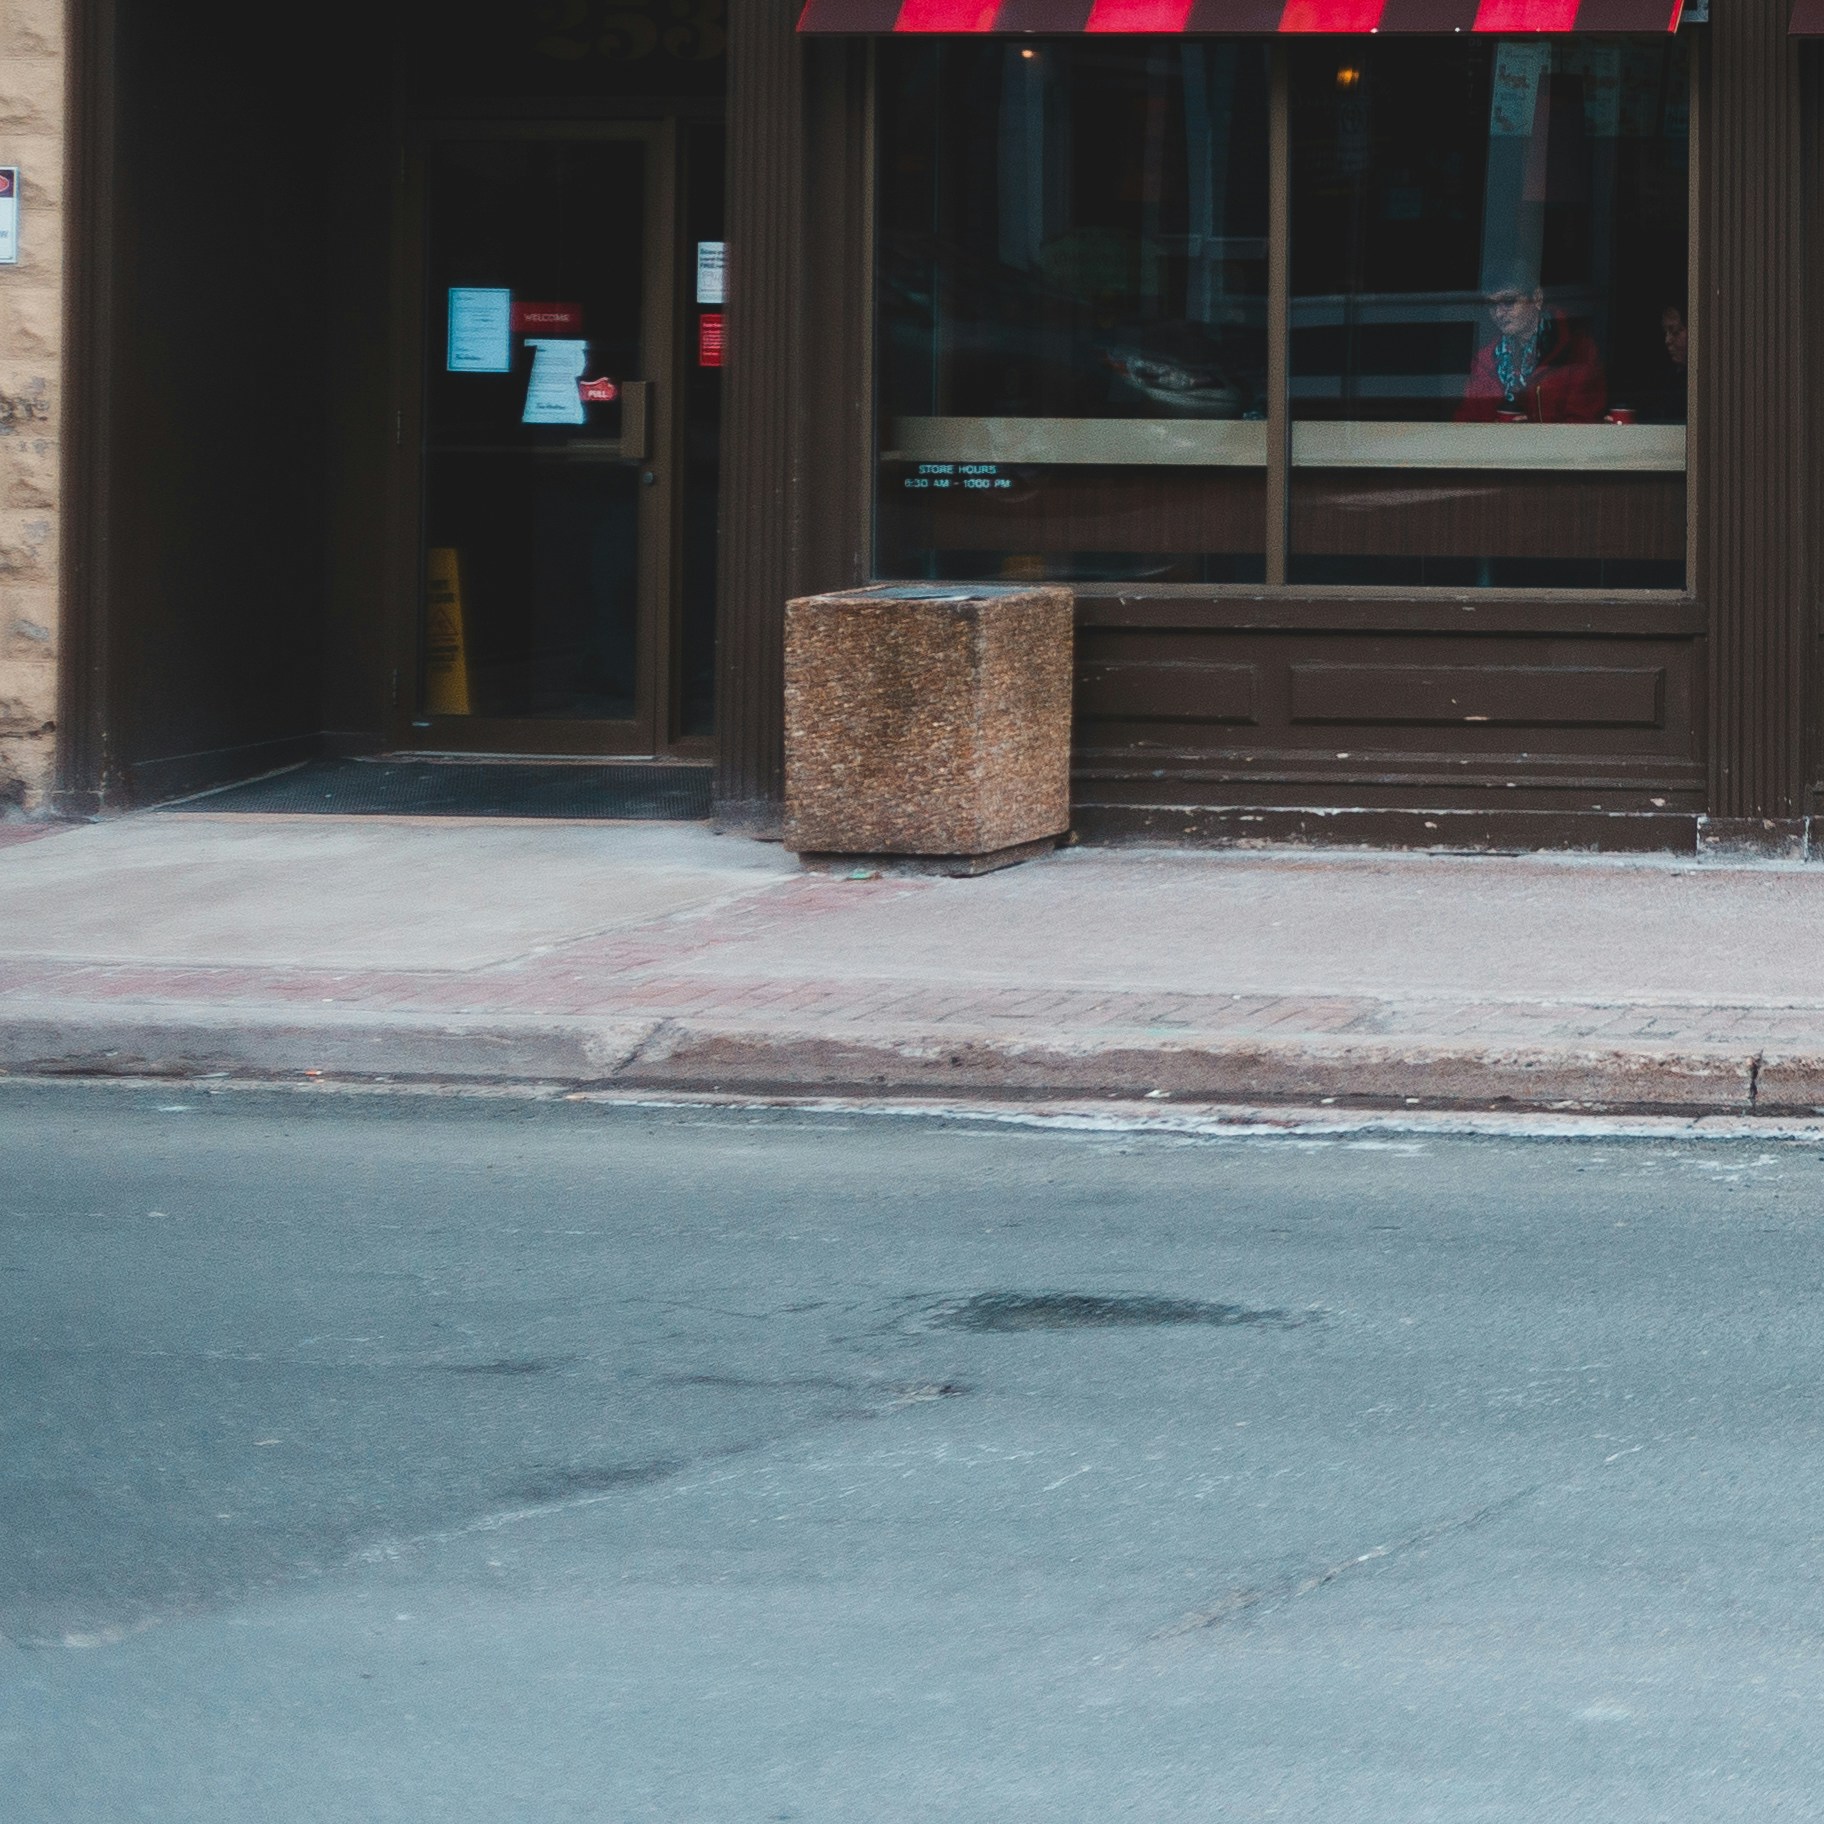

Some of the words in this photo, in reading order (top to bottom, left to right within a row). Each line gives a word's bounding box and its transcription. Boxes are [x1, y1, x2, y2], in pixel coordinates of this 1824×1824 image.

[523, 312, 570, 323] WELCOME
[587, 389, 609, 399] PULL
[918, 464, 954, 475] STORE
[958, 464, 997, 475] HOURS
[933, 479, 950, 488] AM
[994, 479, 1012, 488] PM
